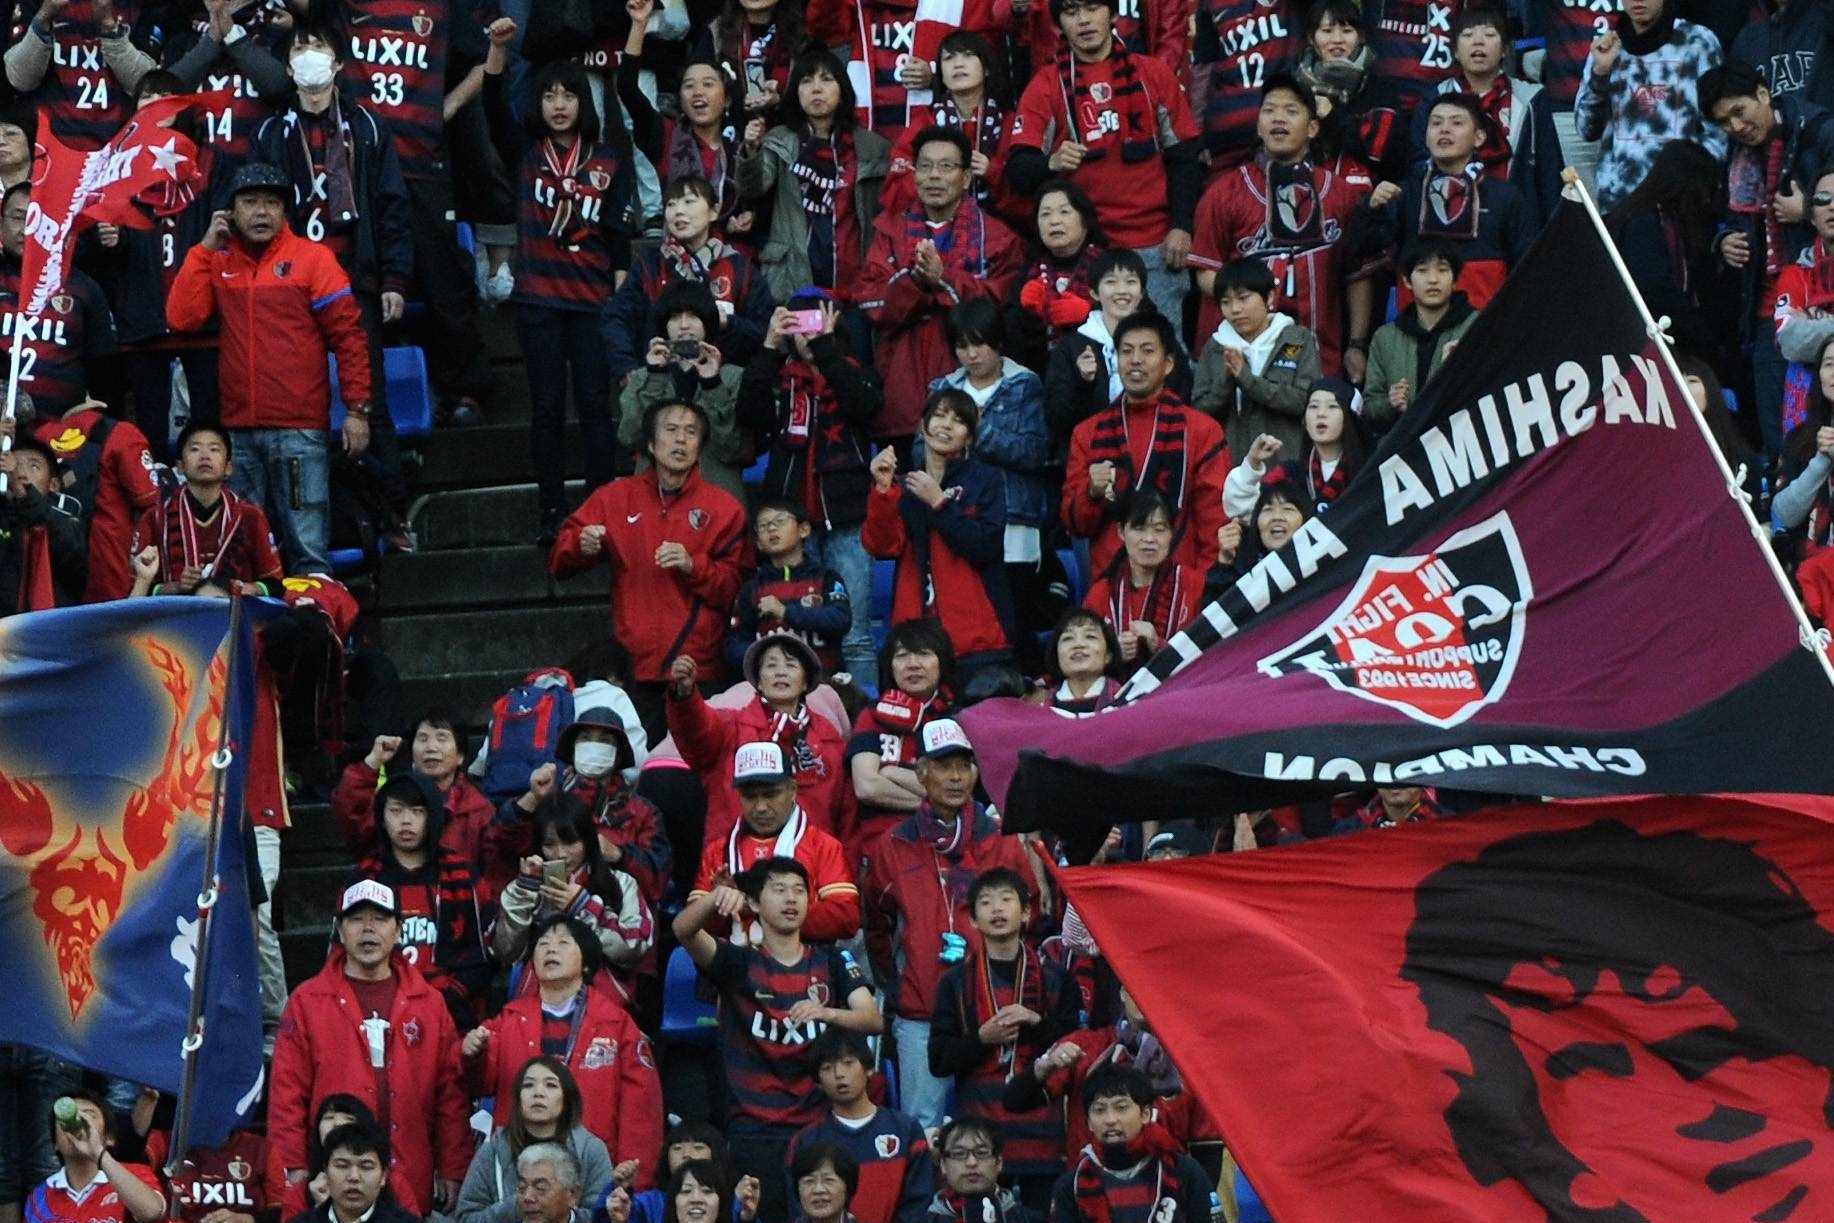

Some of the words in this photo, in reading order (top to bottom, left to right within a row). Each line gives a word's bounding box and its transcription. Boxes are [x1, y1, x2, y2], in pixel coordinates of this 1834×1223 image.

[869, 19, 915, 48] LIX
[1219, 13, 1287, 55] LIXIL
[53, 42, 105, 71] LIX
[351, 37, 429, 70] LIXIL
[1419, 34, 1452, 68] 25
[1237, 52, 1265, 88] 12
[76, 75, 108, 109] 24
[370, 72, 403, 107] 33
[534, 177, 601, 222] LIIL
[306, 208, 325, 241] 6
